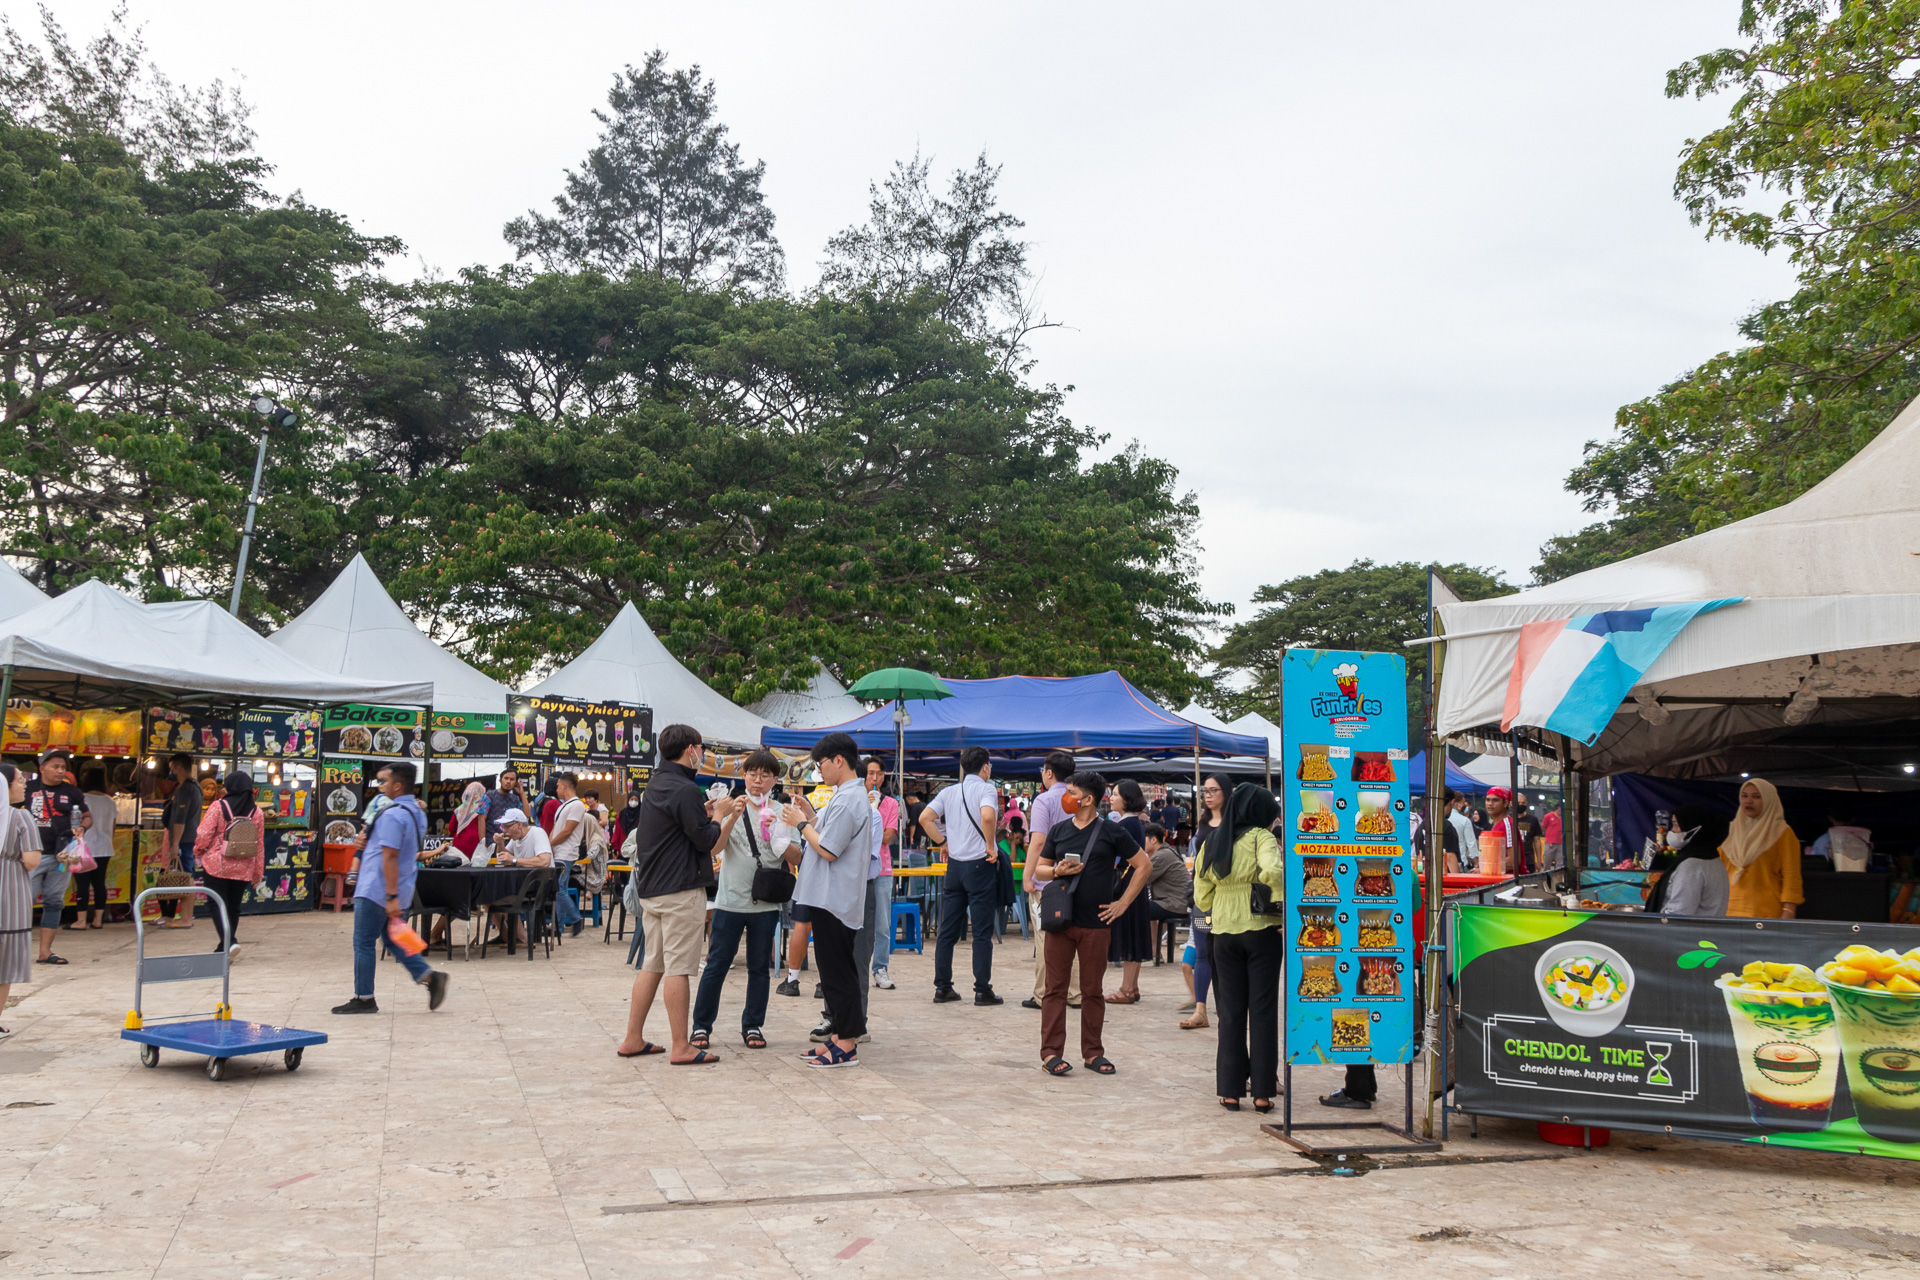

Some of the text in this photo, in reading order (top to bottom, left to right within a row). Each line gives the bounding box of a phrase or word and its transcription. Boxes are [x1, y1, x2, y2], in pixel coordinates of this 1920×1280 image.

[328, 707, 465, 728] Bakso Ree
[323, 767, 361, 784] Ree
[1300, 845, 1397, 855] MOZZARELLA CHEESE
[1504, 1038, 1645, 1068] CHENDOL TIME
[1520, 1063, 1557, 1076] chendol
[1583, 1068, 1615, 1083] happy
[1616, 1071, 1639, 1083] time
